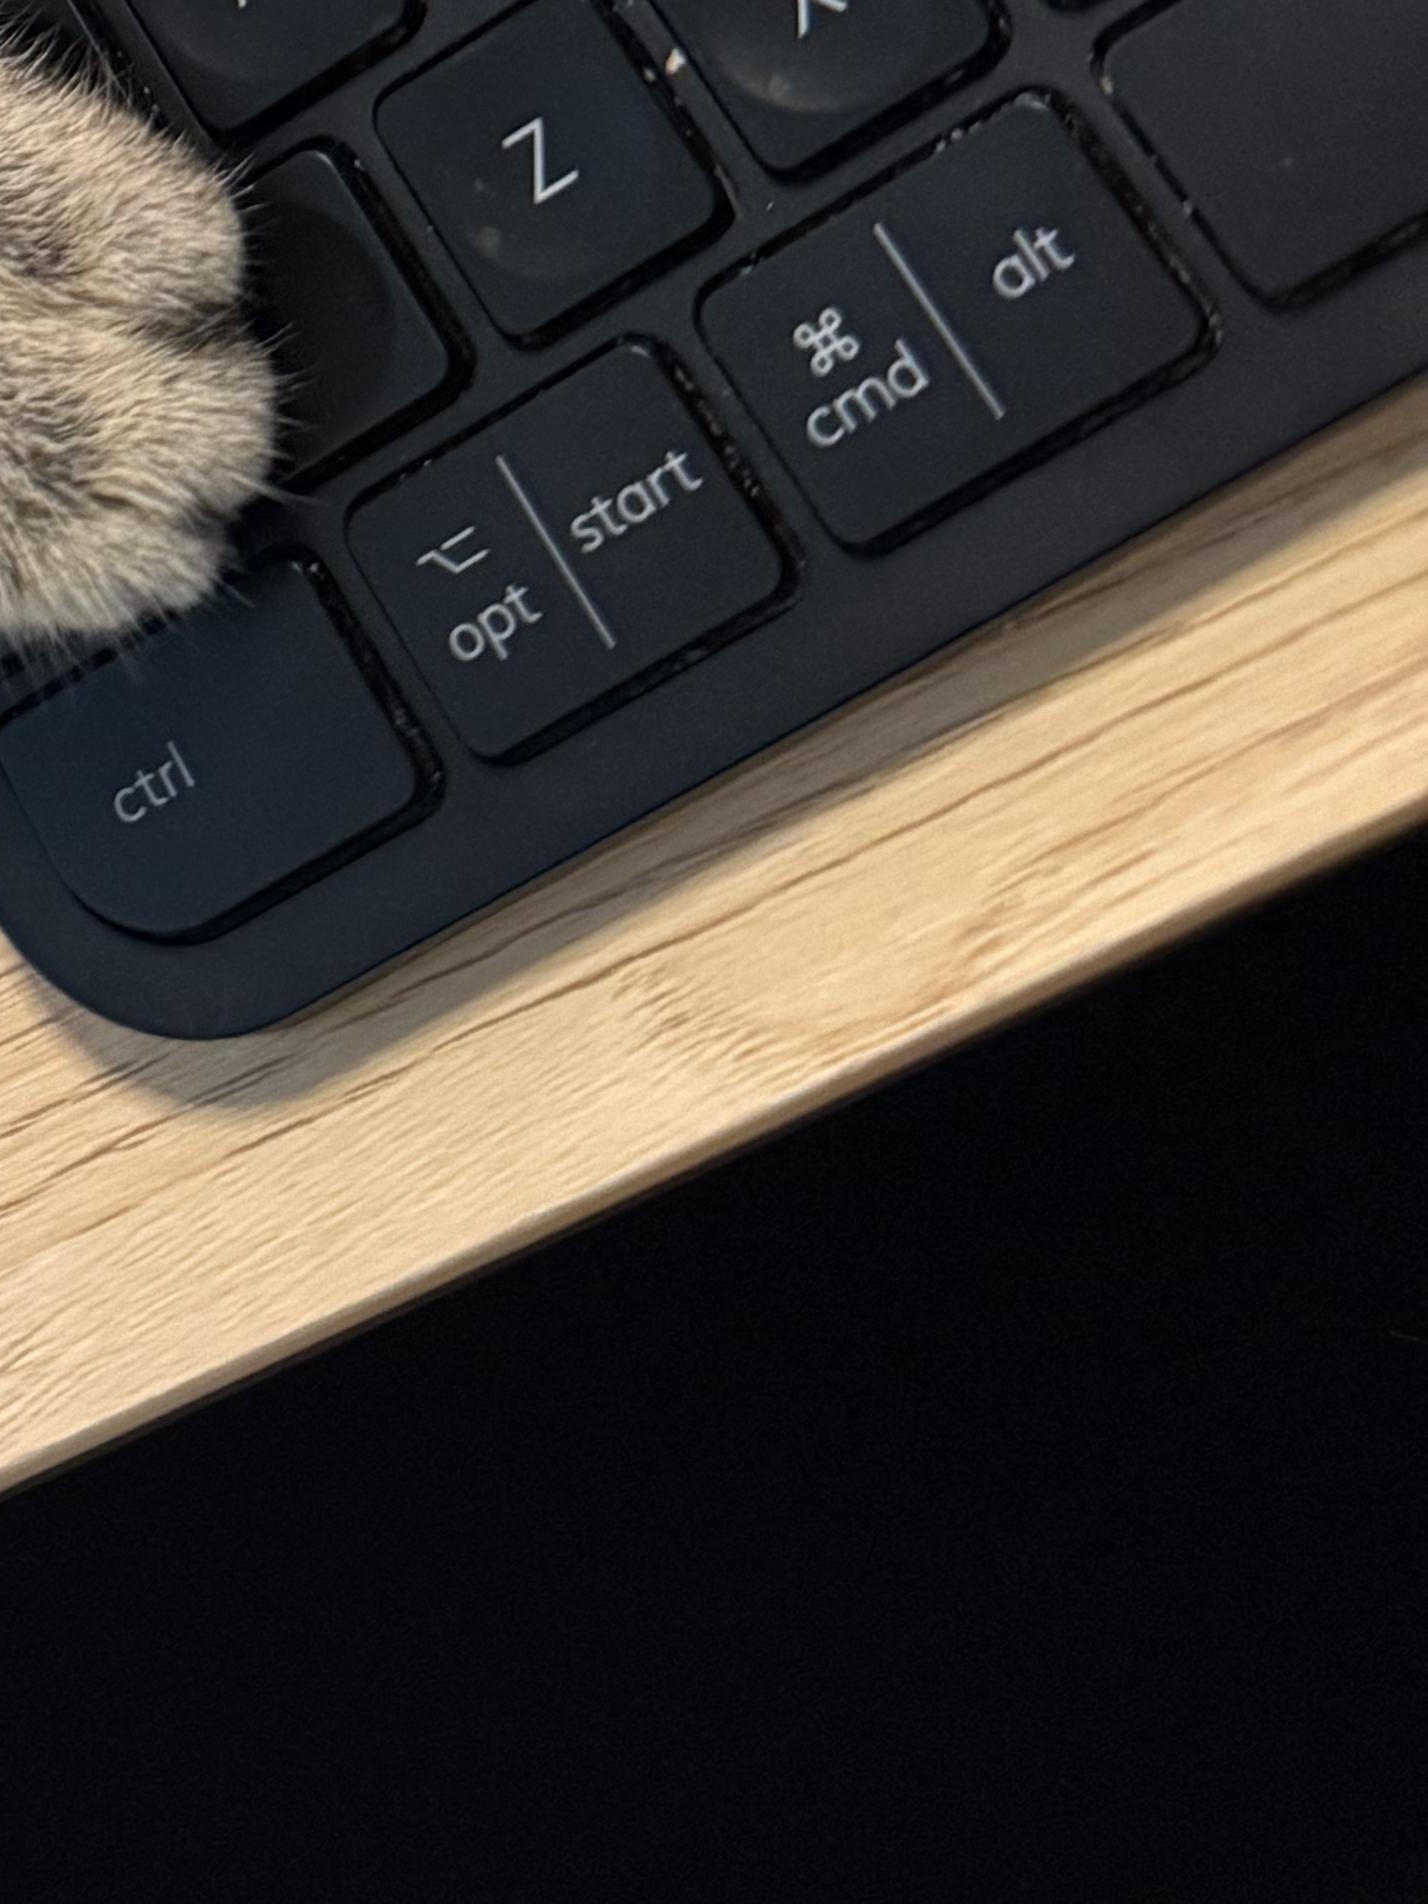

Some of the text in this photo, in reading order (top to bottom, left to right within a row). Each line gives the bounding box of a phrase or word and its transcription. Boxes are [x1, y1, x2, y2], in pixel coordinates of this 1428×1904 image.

[503, 119, 578, 203] Z
[993, 229, 1074, 297] alt
[806, 339, 928, 445] cmd
[571, 452, 702, 552] start
[448, 584, 544, 660] opt
[114, 742, 194, 822] ctrl
